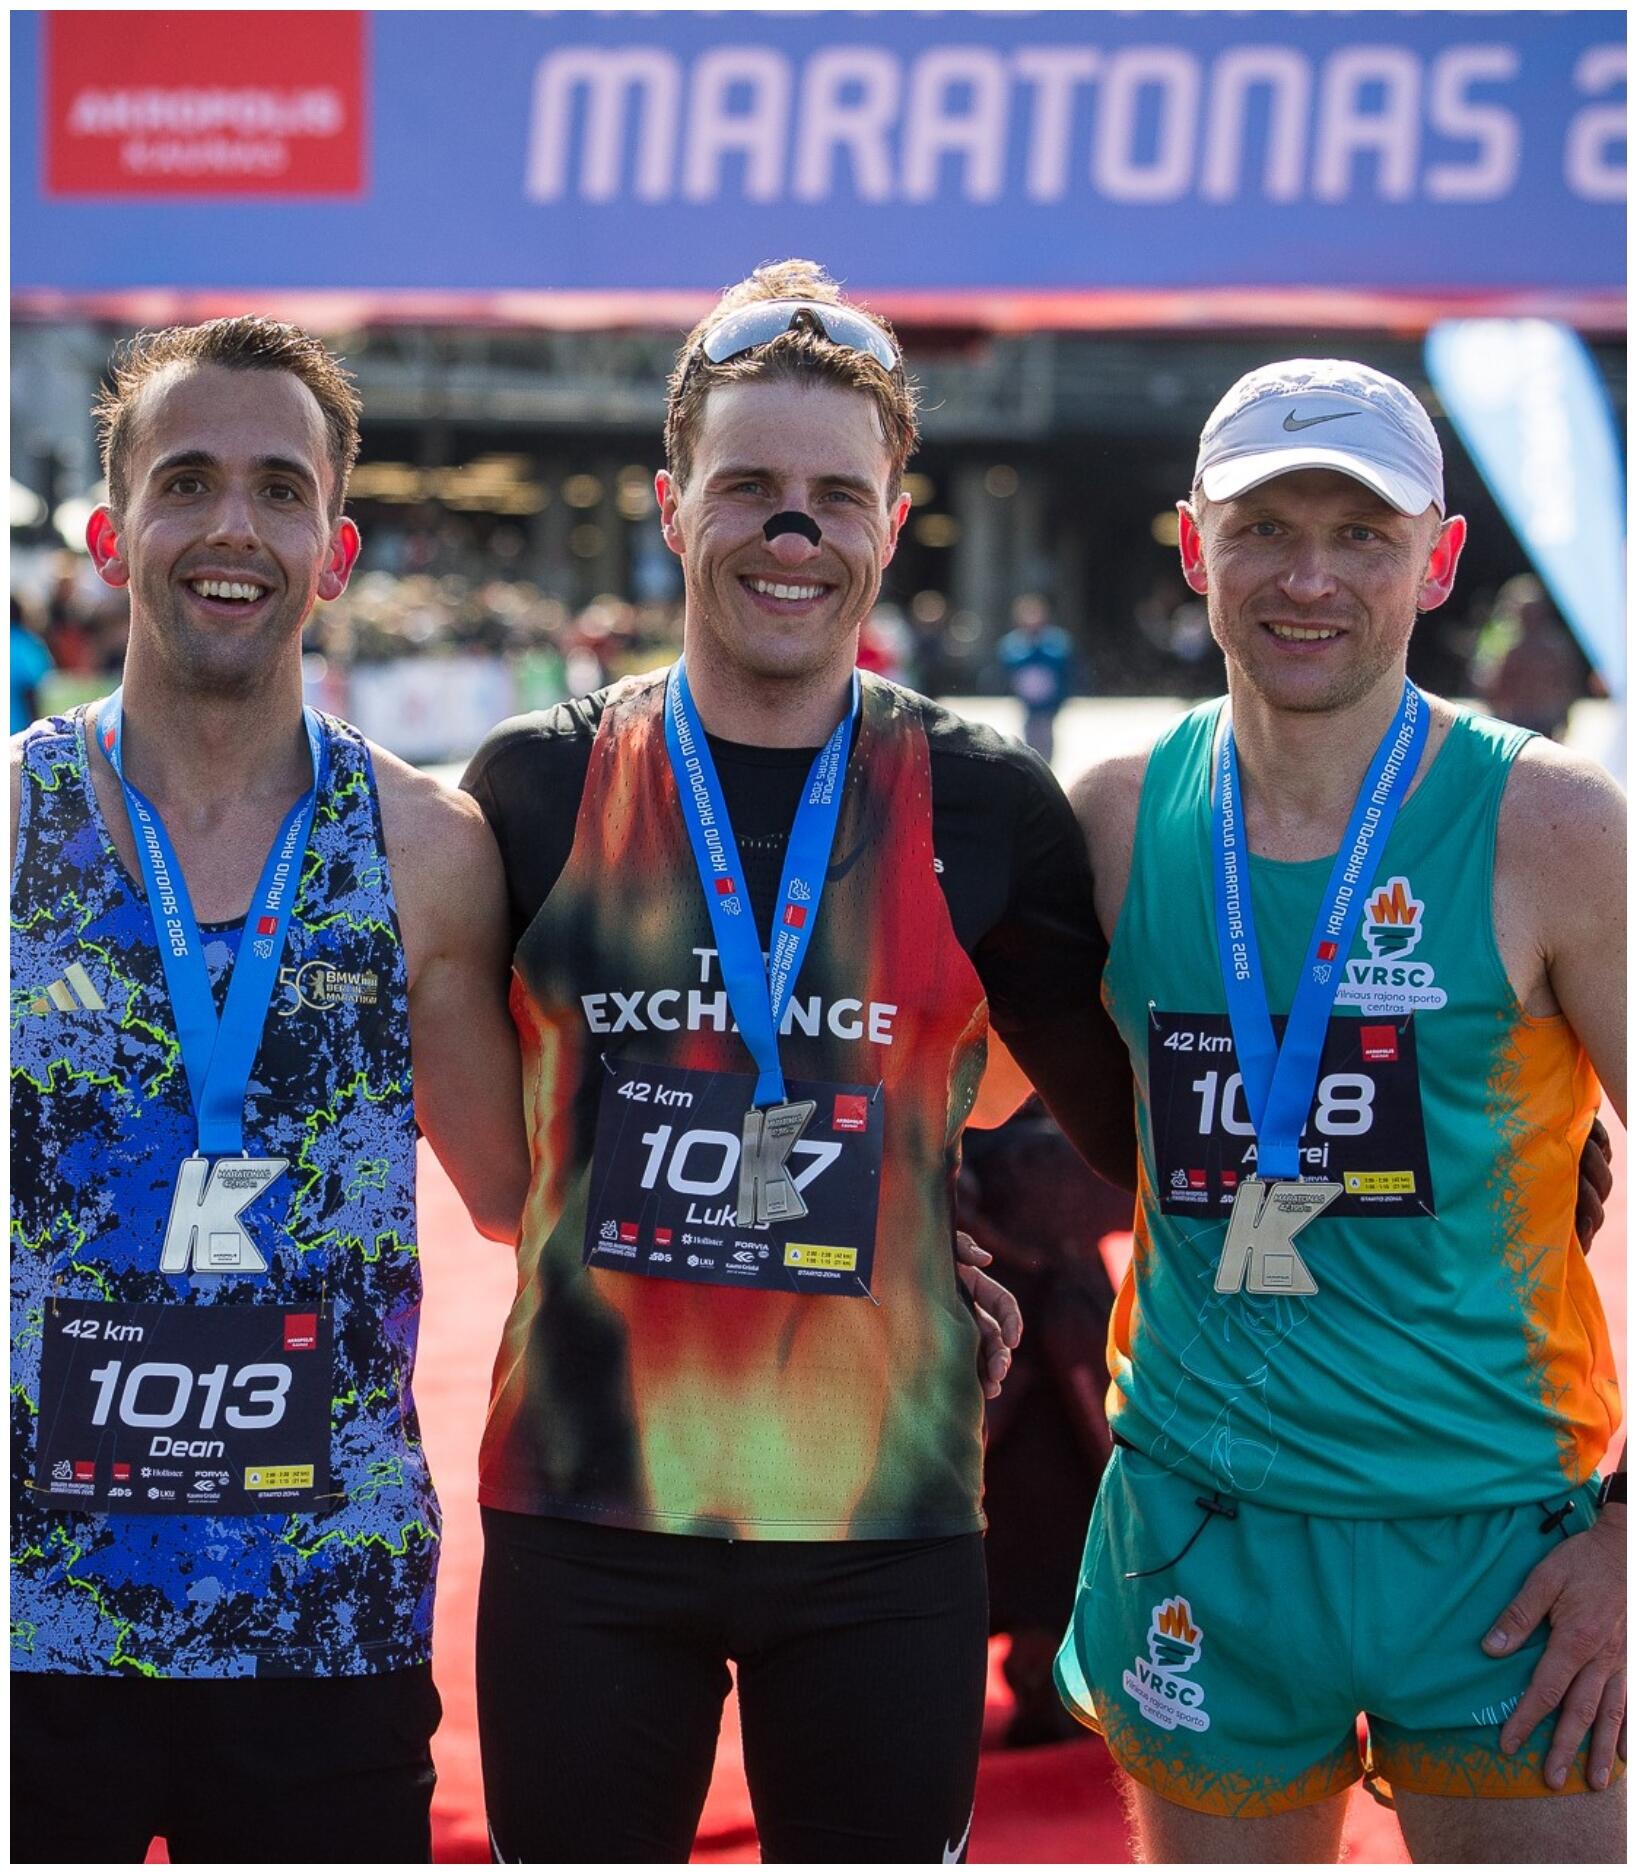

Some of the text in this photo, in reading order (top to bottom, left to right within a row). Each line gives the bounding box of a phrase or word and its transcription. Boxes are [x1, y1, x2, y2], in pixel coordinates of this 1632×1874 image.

[68, 82, 346, 138] AKROPOLIS
[524, 45, 1521, 203] MARATONAS
[685, 757, 716, 826] AKROPOLIO
[1326, 687, 1419, 936] KAUNO AKROPOLIO MARATONAS 2026
[706, 829, 729, 872] KAUNO
[142, 826, 188, 957] MARATONAS 2026
[265, 863, 290, 910] KAUNO
[1223, 850, 1244, 940] MARATONAS
[781, 934, 800, 971] KAUNO
[1232, 942, 1250, 981] 2026
[326, 970, 361, 985] BMW
[1352, 966, 1426, 988] VRSC
[581, 989, 898, 1045] EXCHNGE
[1367, 1003, 1405, 1013] centras
[1374, 992, 1406, 1003] rajono
[1409, 994, 1442, 1005] sporto
[1164, 1032, 1232, 1052] 42 km
[617, 1081, 693, 1108] 42 km
[1193, 1071, 1376, 1136] 108
[640, 1125, 842, 1197] 107
[1241, 1142, 1329, 1168] Arej
[62, 1319, 144, 1343] 42 km
[90, 1360, 293, 1430] 1013
[149, 1436, 225, 1459] Dean
[1139, 1664, 1197, 1707] VRSC
[1143, 1702, 1173, 1725] centras
[1175, 1706, 1206, 1728] sporto
